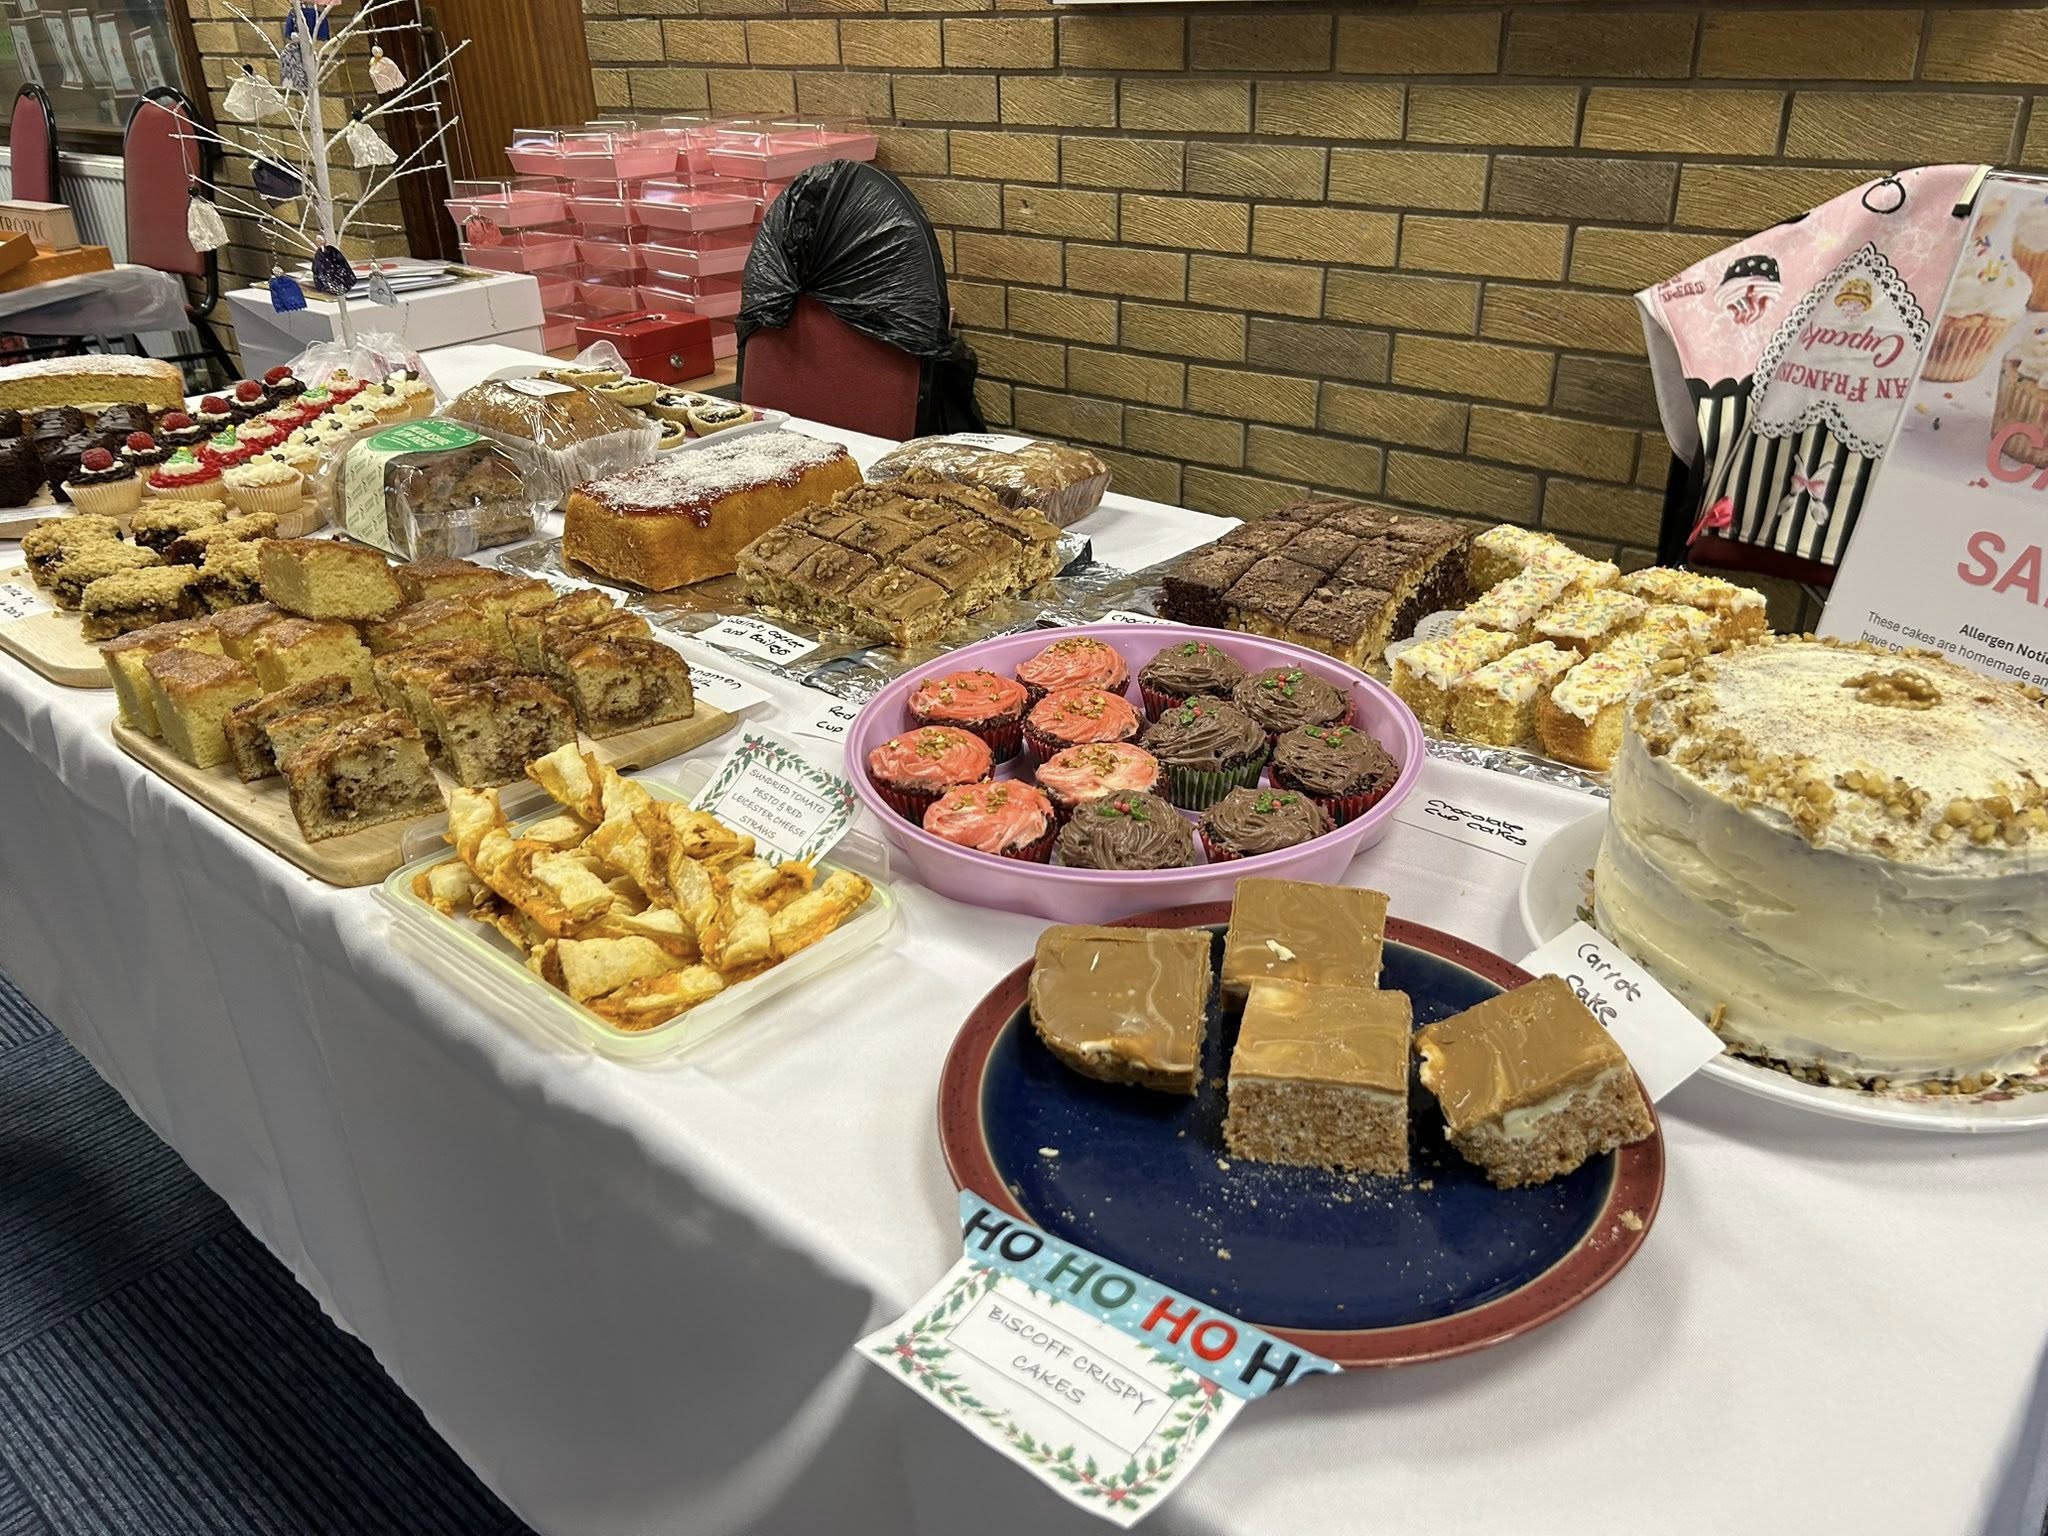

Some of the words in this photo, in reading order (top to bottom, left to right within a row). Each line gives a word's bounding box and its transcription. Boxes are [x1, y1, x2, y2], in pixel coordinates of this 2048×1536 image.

[1874, 377, 1909, 399] AN
[1986, 421, 2048, 491] C
[1957, 531, 2048, 609] SA
[1860, 630, 1888, 648] have
[1868, 611, 1901, 632] These
[1902, 626, 1936, 645] cakes
[1938, 638, 1957, 653] are
[1957, 644, 2030, 680] homemade
[1959, 624, 2014, 652] Allergen
[815, 720, 844, 733] Cup
[828, 705, 857, 721] Red
[731, 792, 774, 821] LEICESTER
[773, 816, 807, 838] CHEESE
[749, 769, 791, 795] SUNDRIED
[788, 790, 826, 815] TOMATO
[752, 786, 780, 807] PESTO
[785, 804, 803, 819] RED
[739, 815, 777, 840] STRAWS
[1577, 943, 1641, 1002] Carrot
[964, 1208, 1043, 1262] HO
[1043, 1252, 1137, 1310] HO
[1140, 1294, 1239, 1362] HO
[987, 1303, 1074, 1360] BISCOFF
[1072, 1355, 1156, 1415] CRISPY
[1011, 1354, 1087, 1404] CAKES
